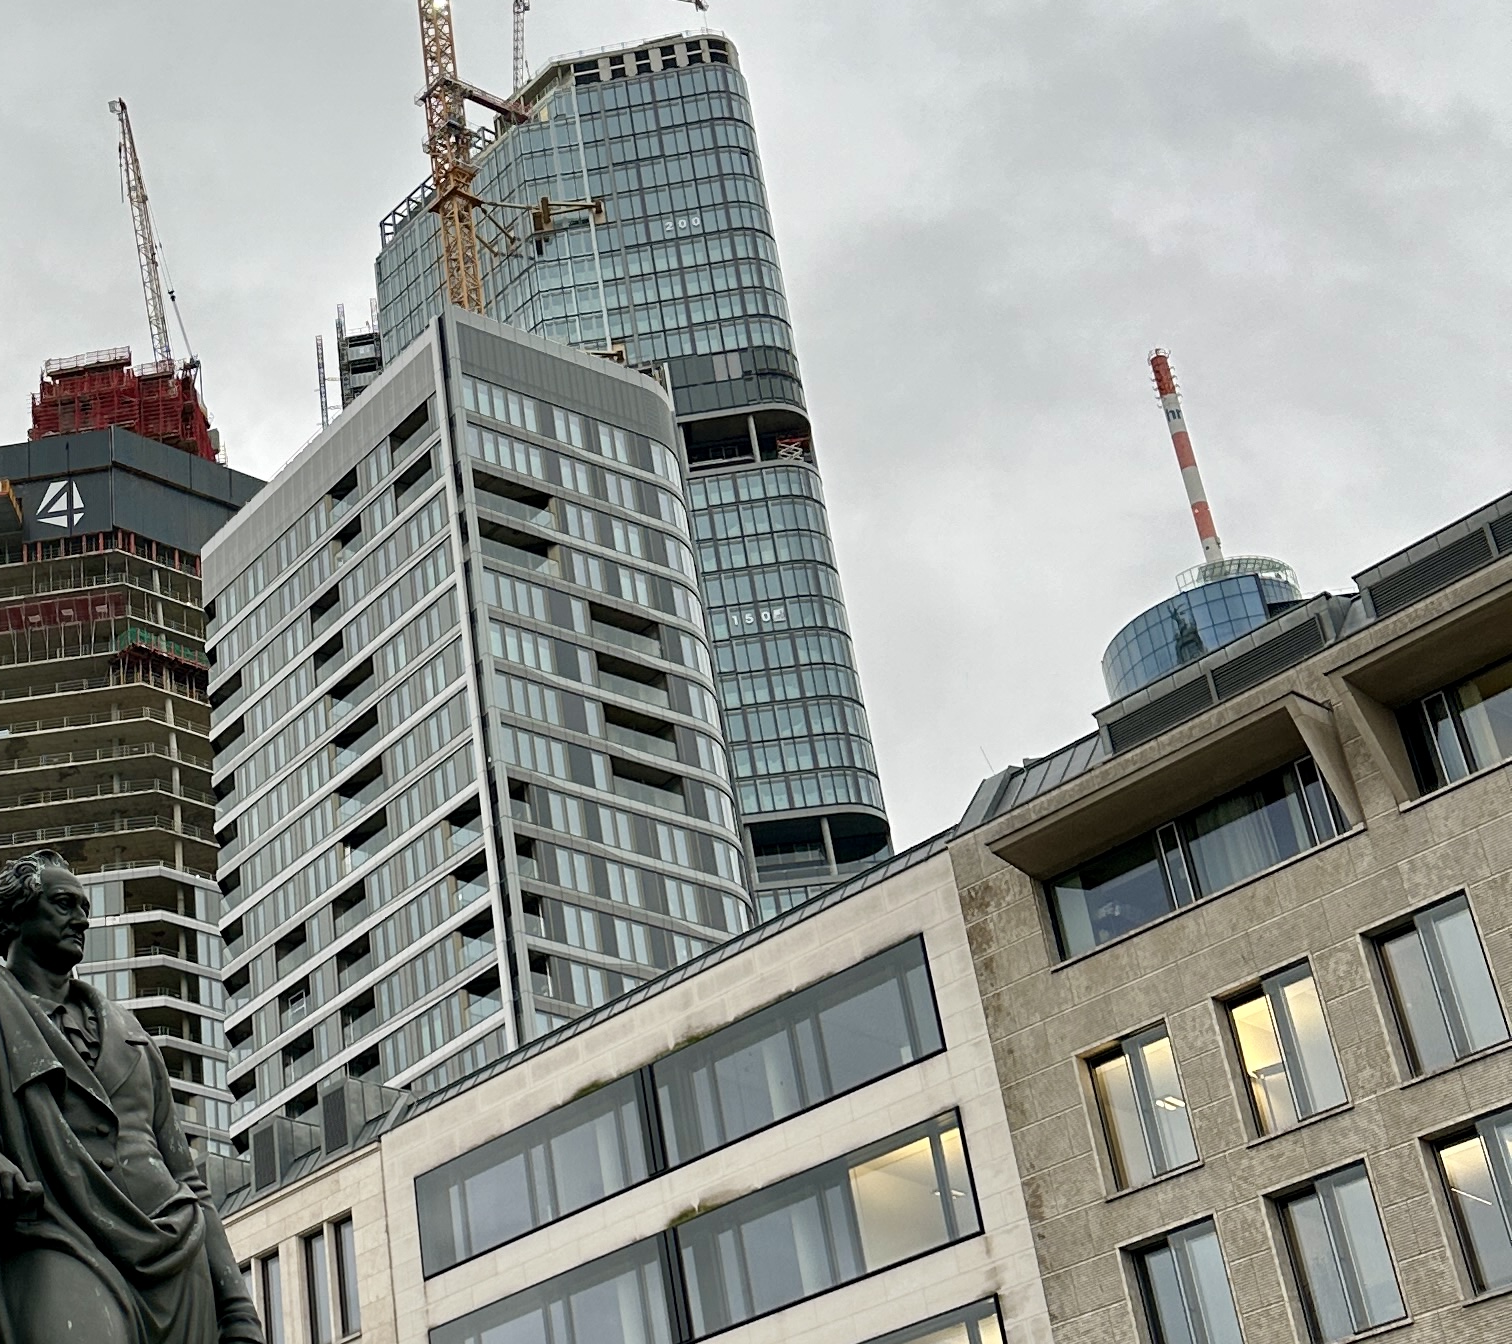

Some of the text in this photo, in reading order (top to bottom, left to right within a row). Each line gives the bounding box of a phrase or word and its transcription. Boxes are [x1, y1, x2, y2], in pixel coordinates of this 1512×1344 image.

[665, 217, 700, 231] 200
[1166, 408, 1182, 422] hr
[732, 611, 771, 626] 150
